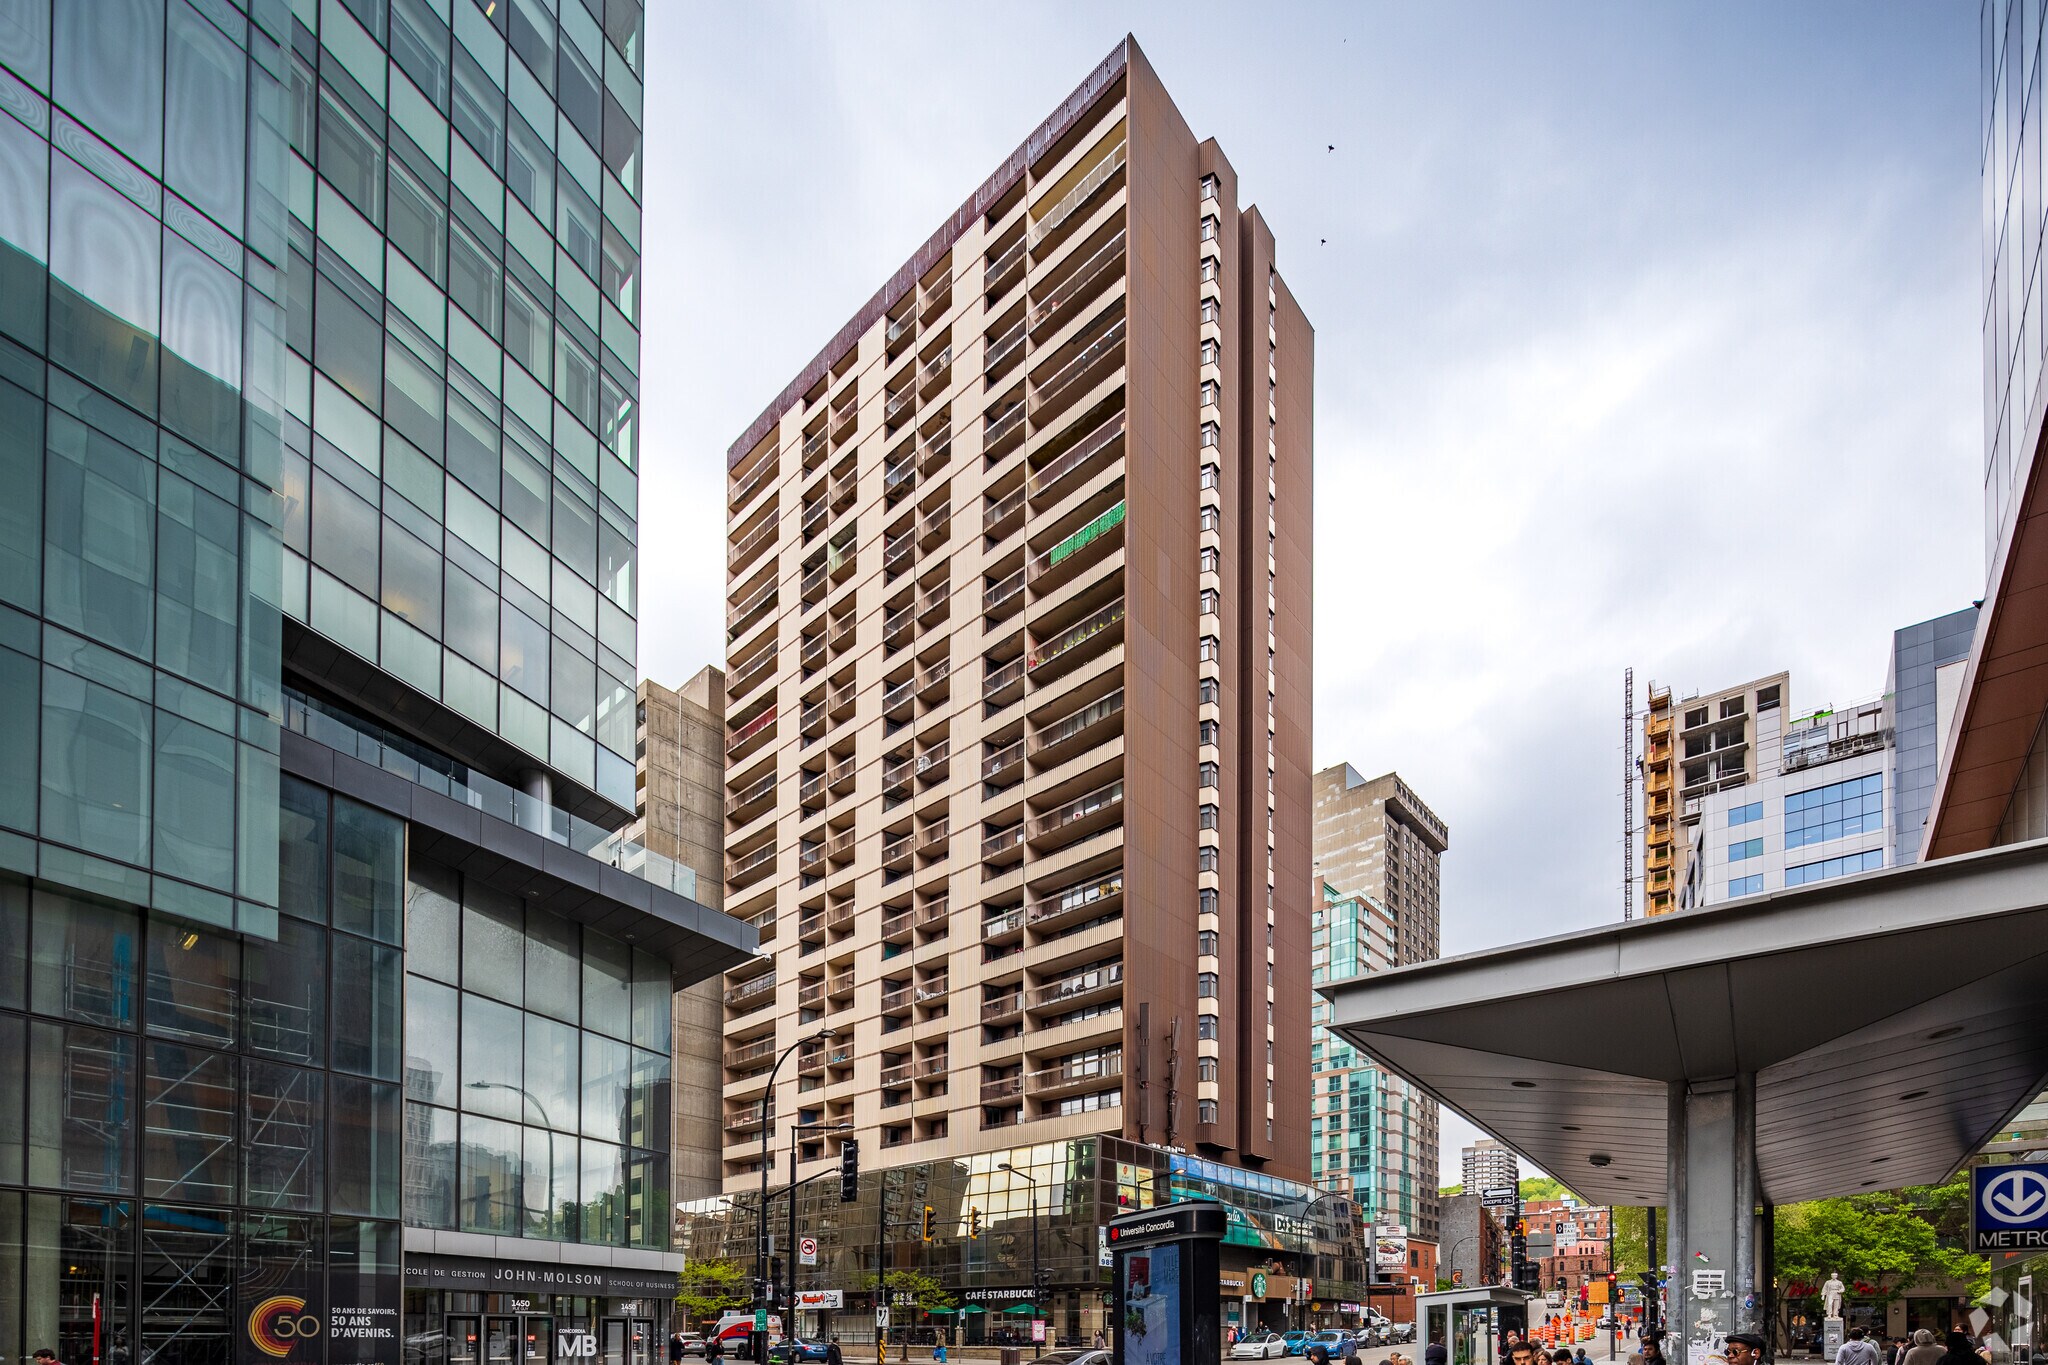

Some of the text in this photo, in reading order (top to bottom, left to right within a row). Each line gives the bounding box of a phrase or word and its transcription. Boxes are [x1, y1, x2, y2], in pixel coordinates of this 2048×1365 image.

[1120, 1224, 1145, 1237] Université
[1145, 1219, 1175, 1232] Concordia
[434, 1269, 445, 1277] DE
[494, 1269, 601, 1285] JOHN-MOLSON
[646, 1282, 675, 1290] BUSINESS
[965, 1289, 987, 1300] CAFÉ
[367, 1308, 398, 1316] SAVOIRS,
[274, 1315, 320, 1338] 50
[331, 1316, 371, 1326] 50 ANS
[558, 1335, 597, 1357] MB
